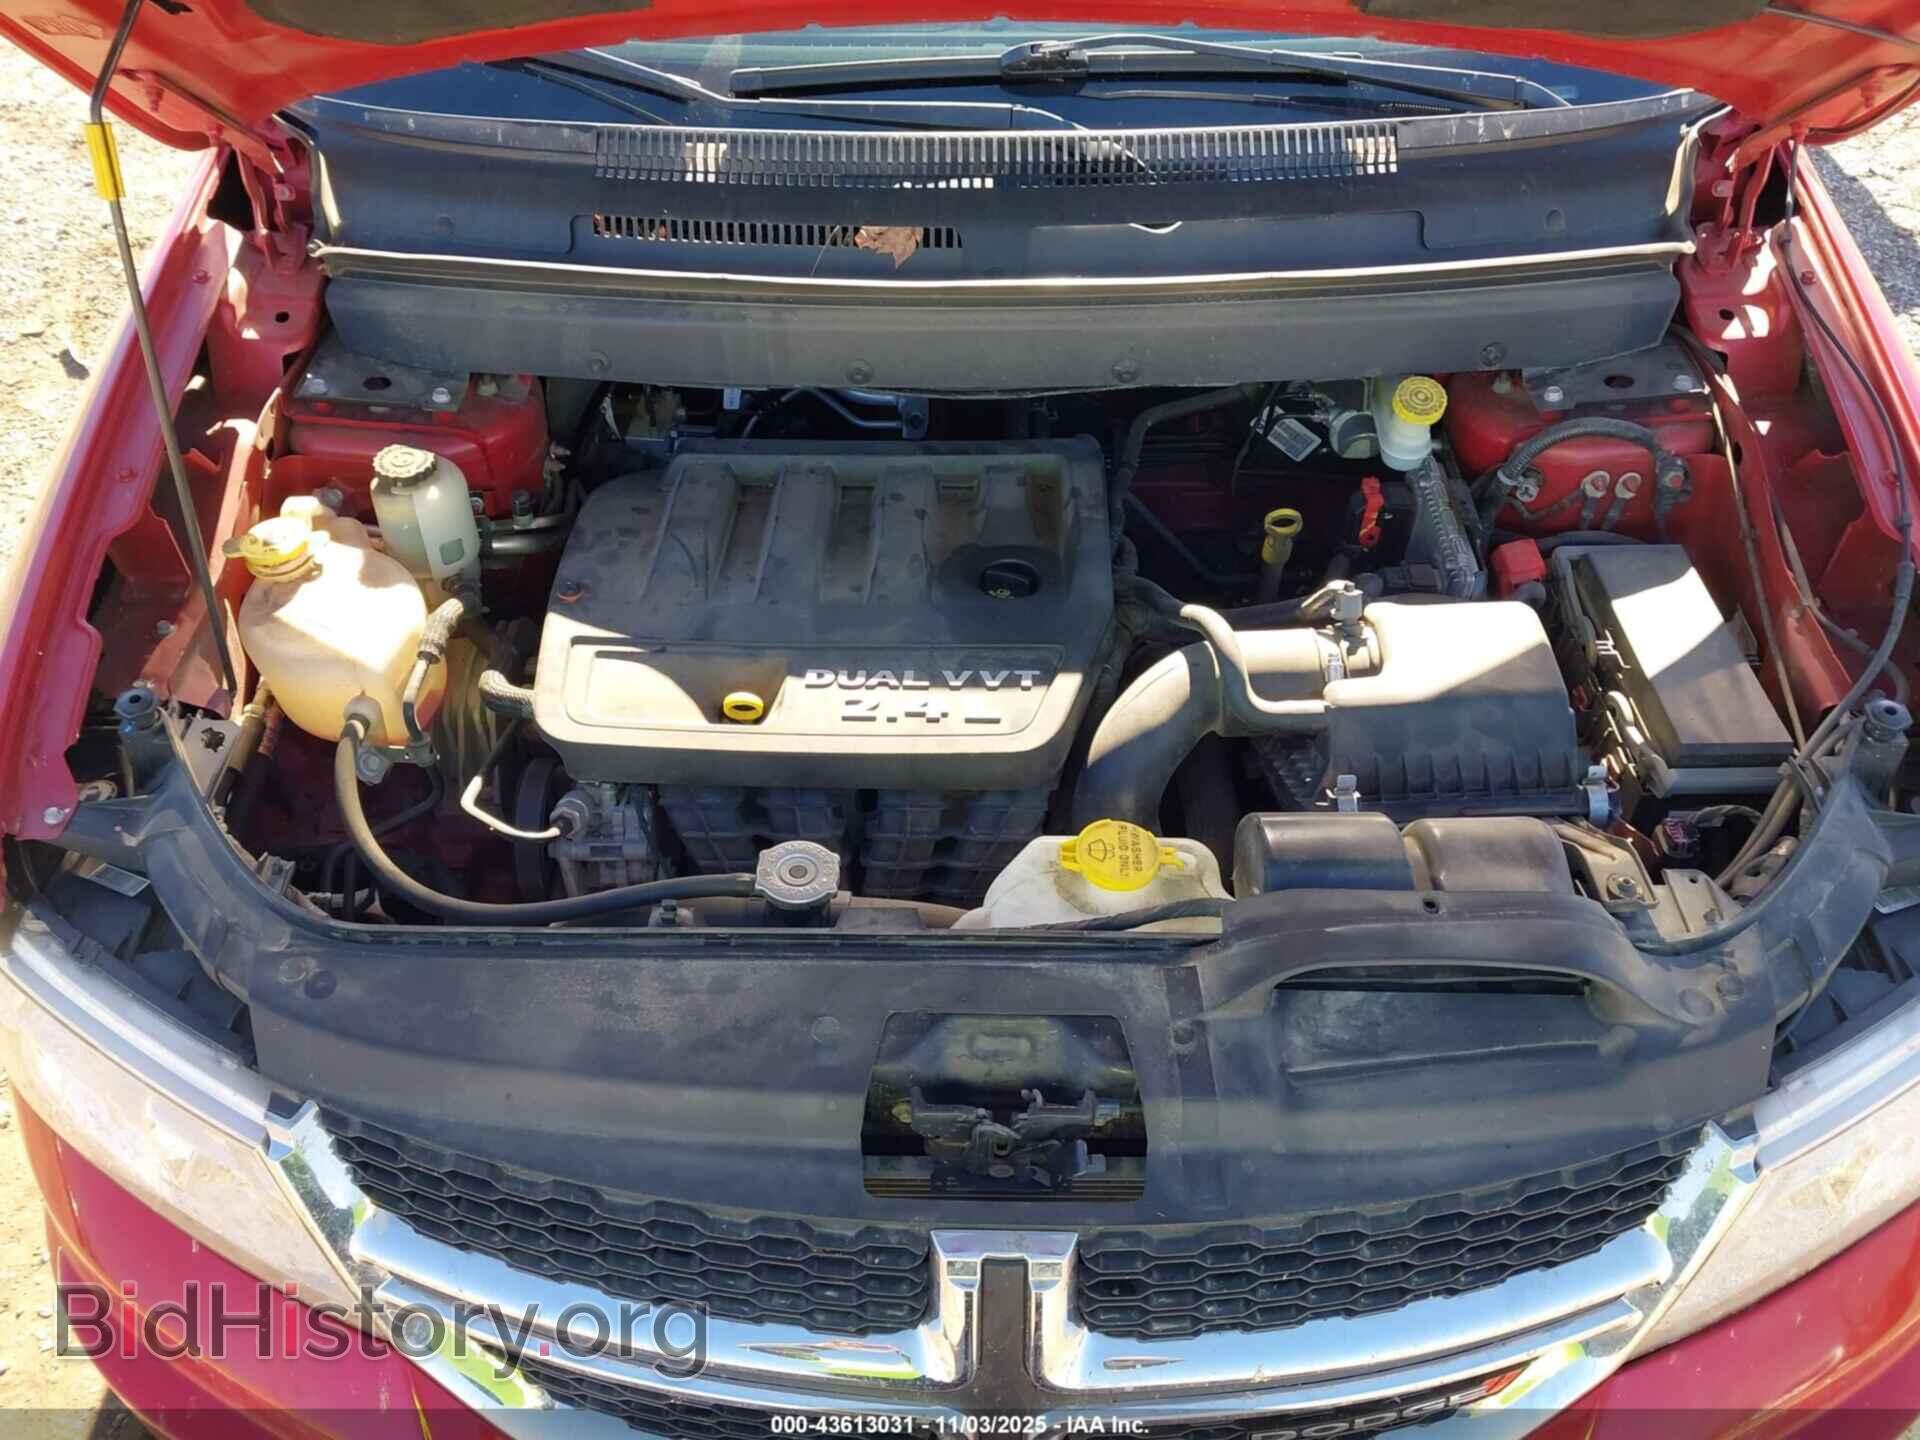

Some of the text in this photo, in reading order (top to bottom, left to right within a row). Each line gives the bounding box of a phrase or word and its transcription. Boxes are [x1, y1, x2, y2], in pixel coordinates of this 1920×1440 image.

[804, 668, 1041, 691] DUAL VVT
[1118, 825, 1131, 880] FLUID ONLY
[1130, 826, 1143, 873] WASHER
